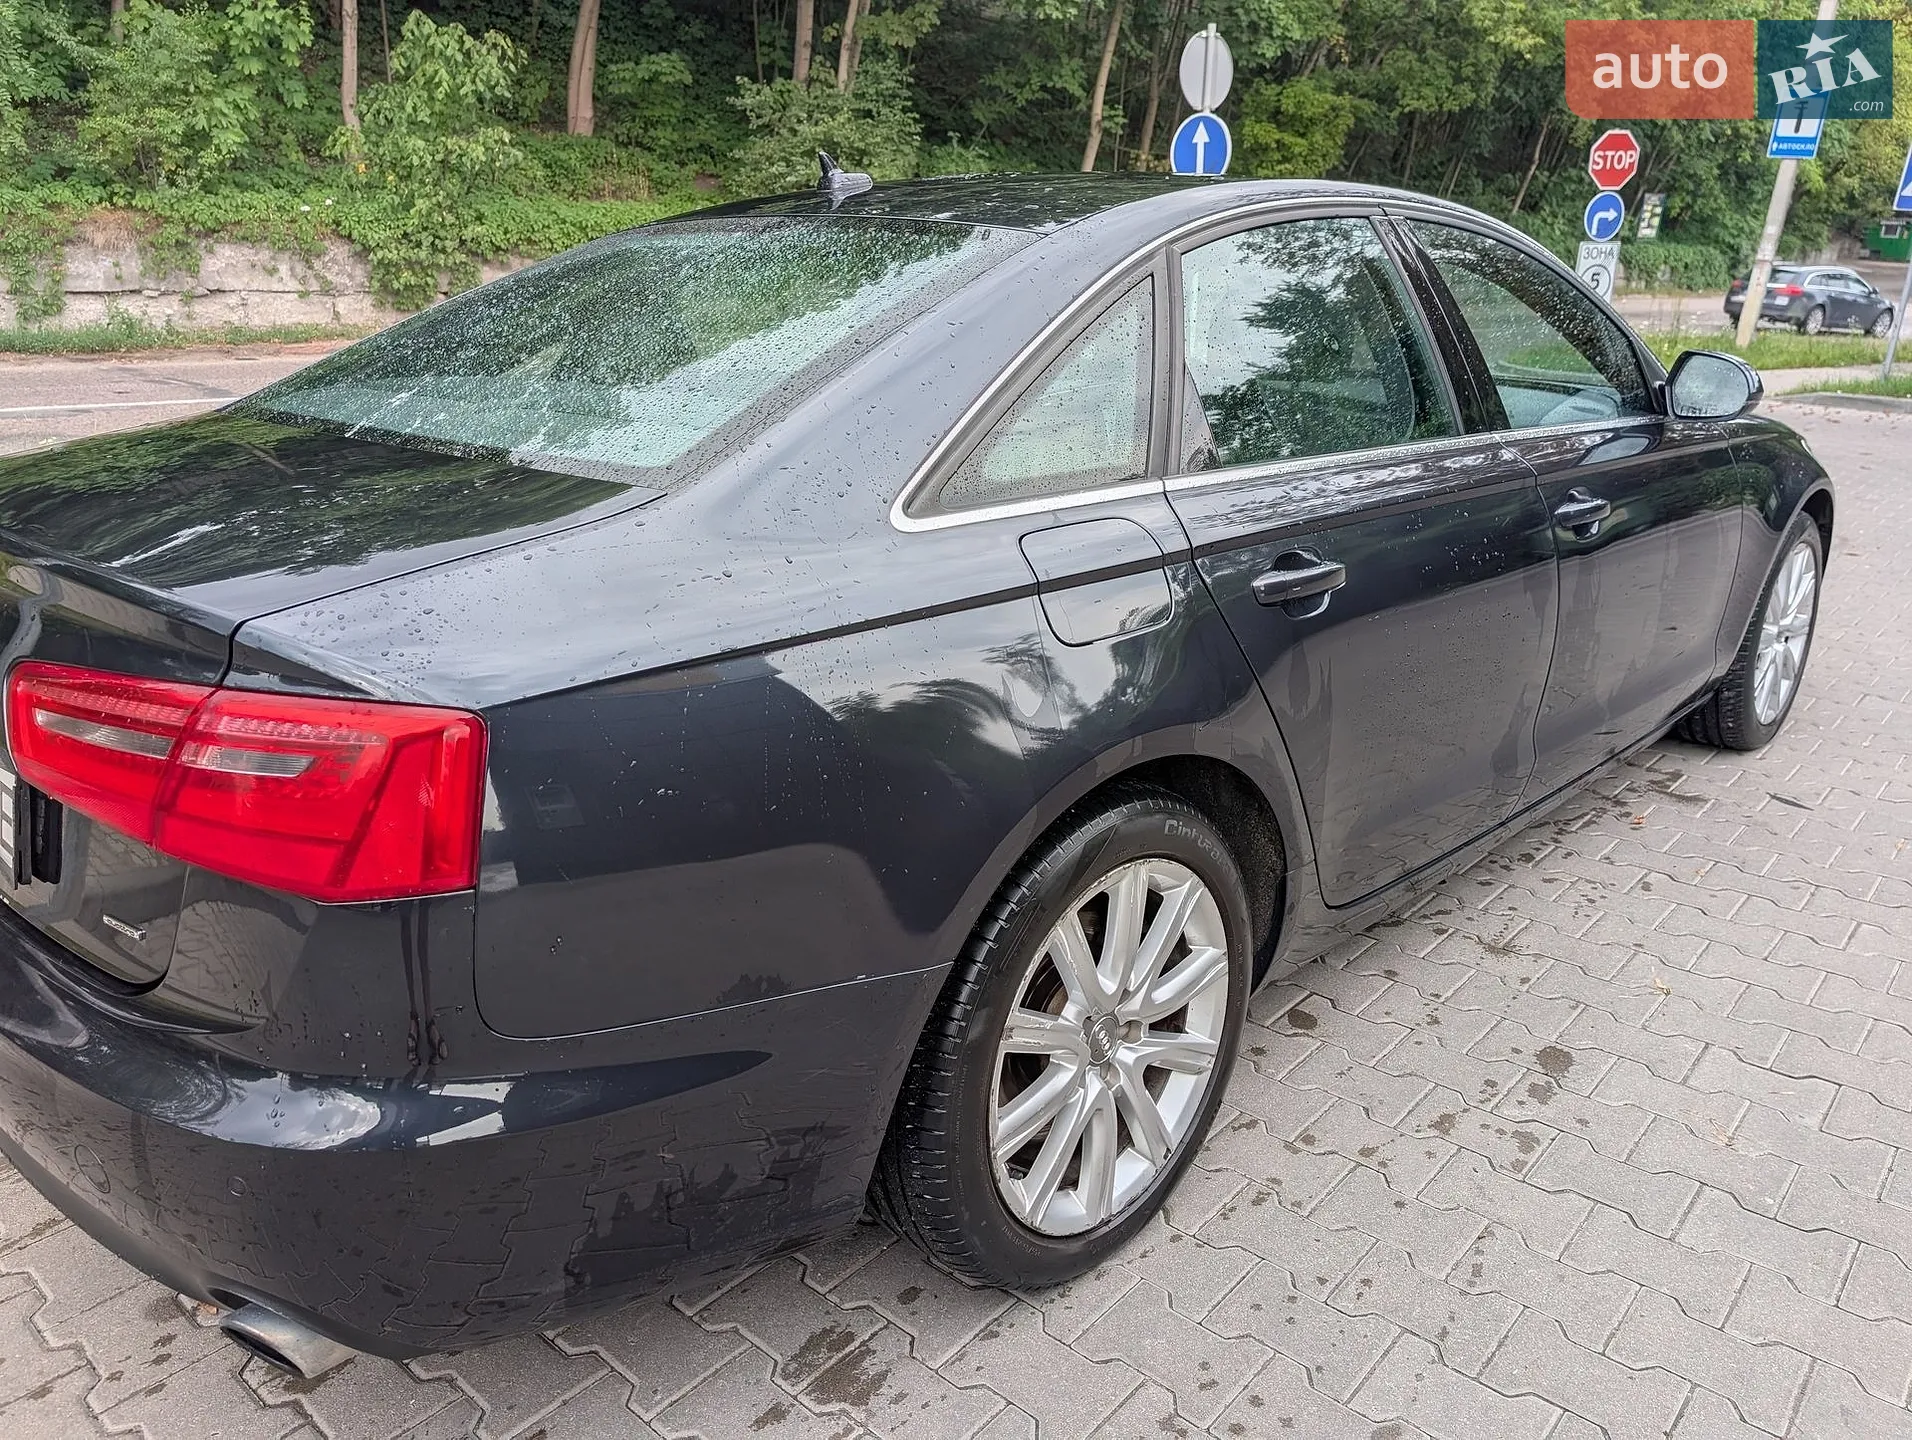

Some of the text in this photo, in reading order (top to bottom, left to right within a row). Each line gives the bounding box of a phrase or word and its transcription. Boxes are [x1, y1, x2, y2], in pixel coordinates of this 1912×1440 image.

[1592, 150, 1636, 170] STOP
[1583, 246, 1615, 260] ЗОНА
[1591, 272, 1601, 290] 5
